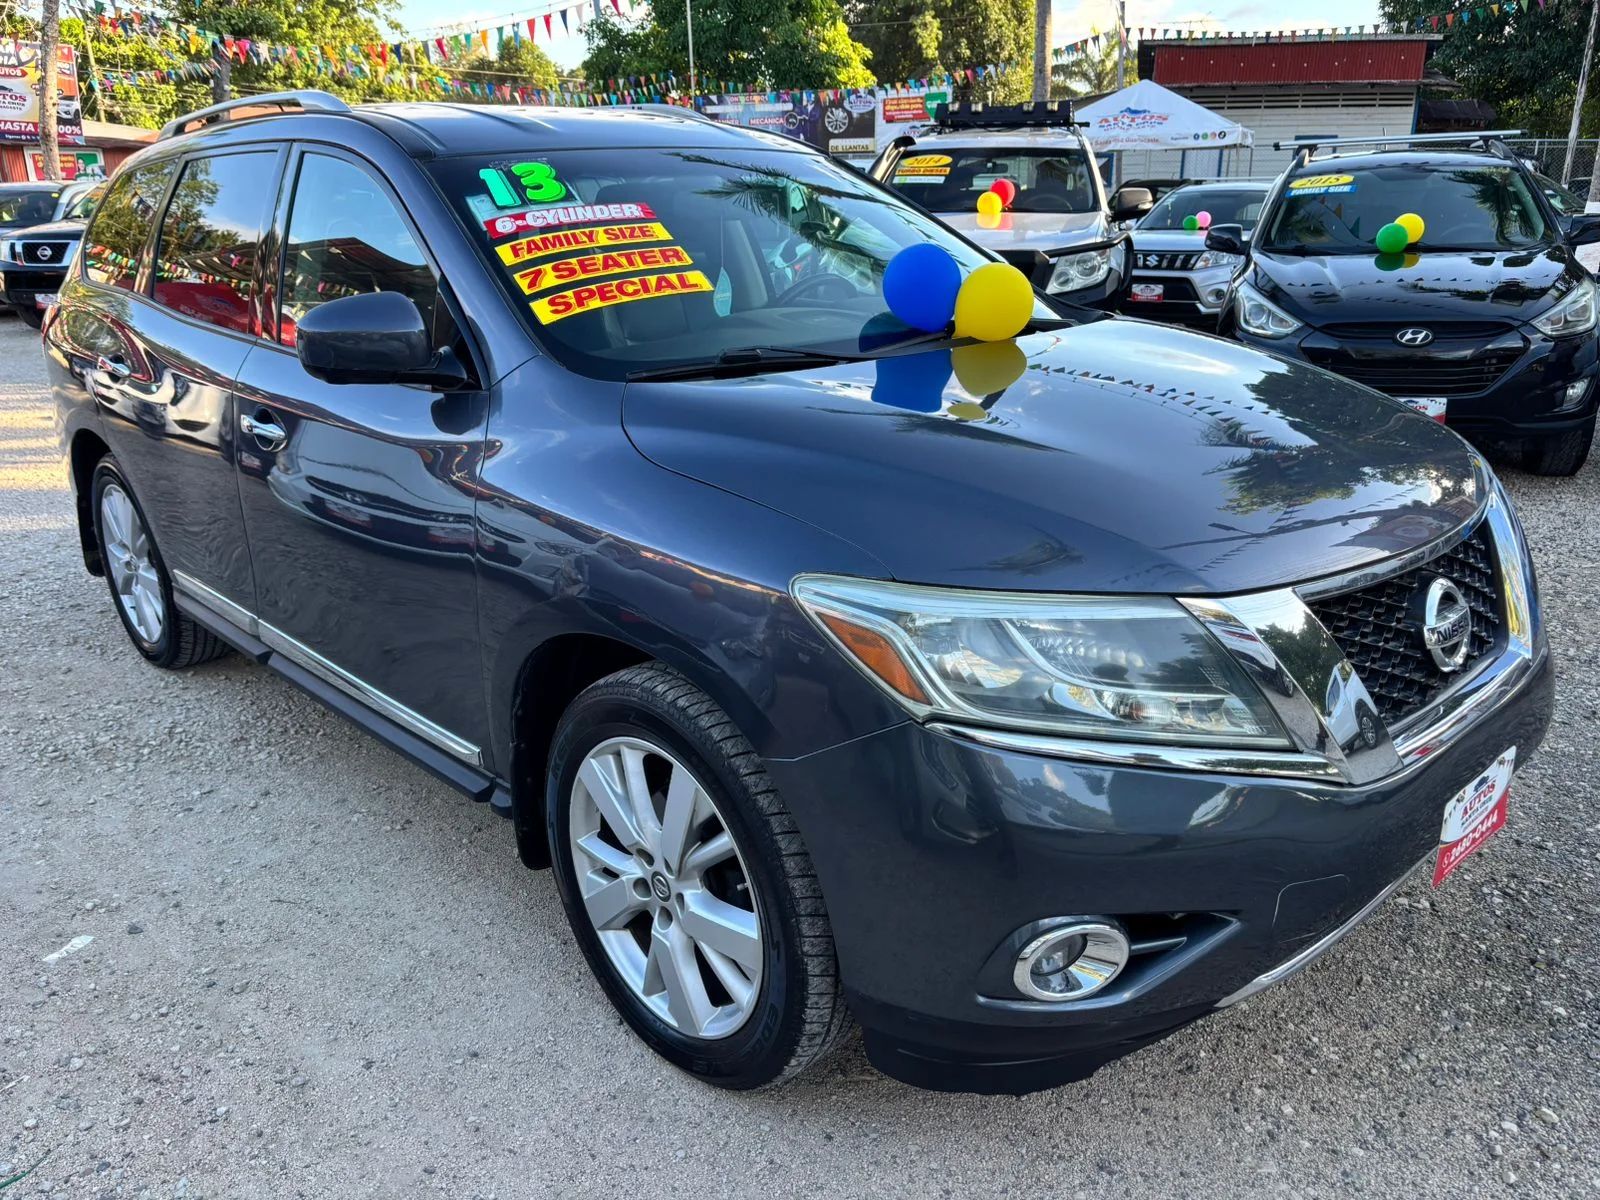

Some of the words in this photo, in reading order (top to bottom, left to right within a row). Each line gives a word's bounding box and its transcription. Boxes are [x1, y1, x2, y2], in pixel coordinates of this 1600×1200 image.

[908, 156, 945, 166] 2014
[479, 161, 566, 207] 13
[1291, 186, 1328, 196] FAMILY
[1328, 185, 1353, 193] SIZE
[1299, 175, 1344, 187] 2015
[495, 203, 643, 233] 6-CYLINDER
[510, 229, 600, 258] FAMILY
[606, 224, 655, 241] SIZE
[519, 268, 547, 291] 7
[552, 247, 687, 281] SEATER
[547, 273, 700, 316] SPECIAL
[1461, 778, 1497, 818] AUTOS
